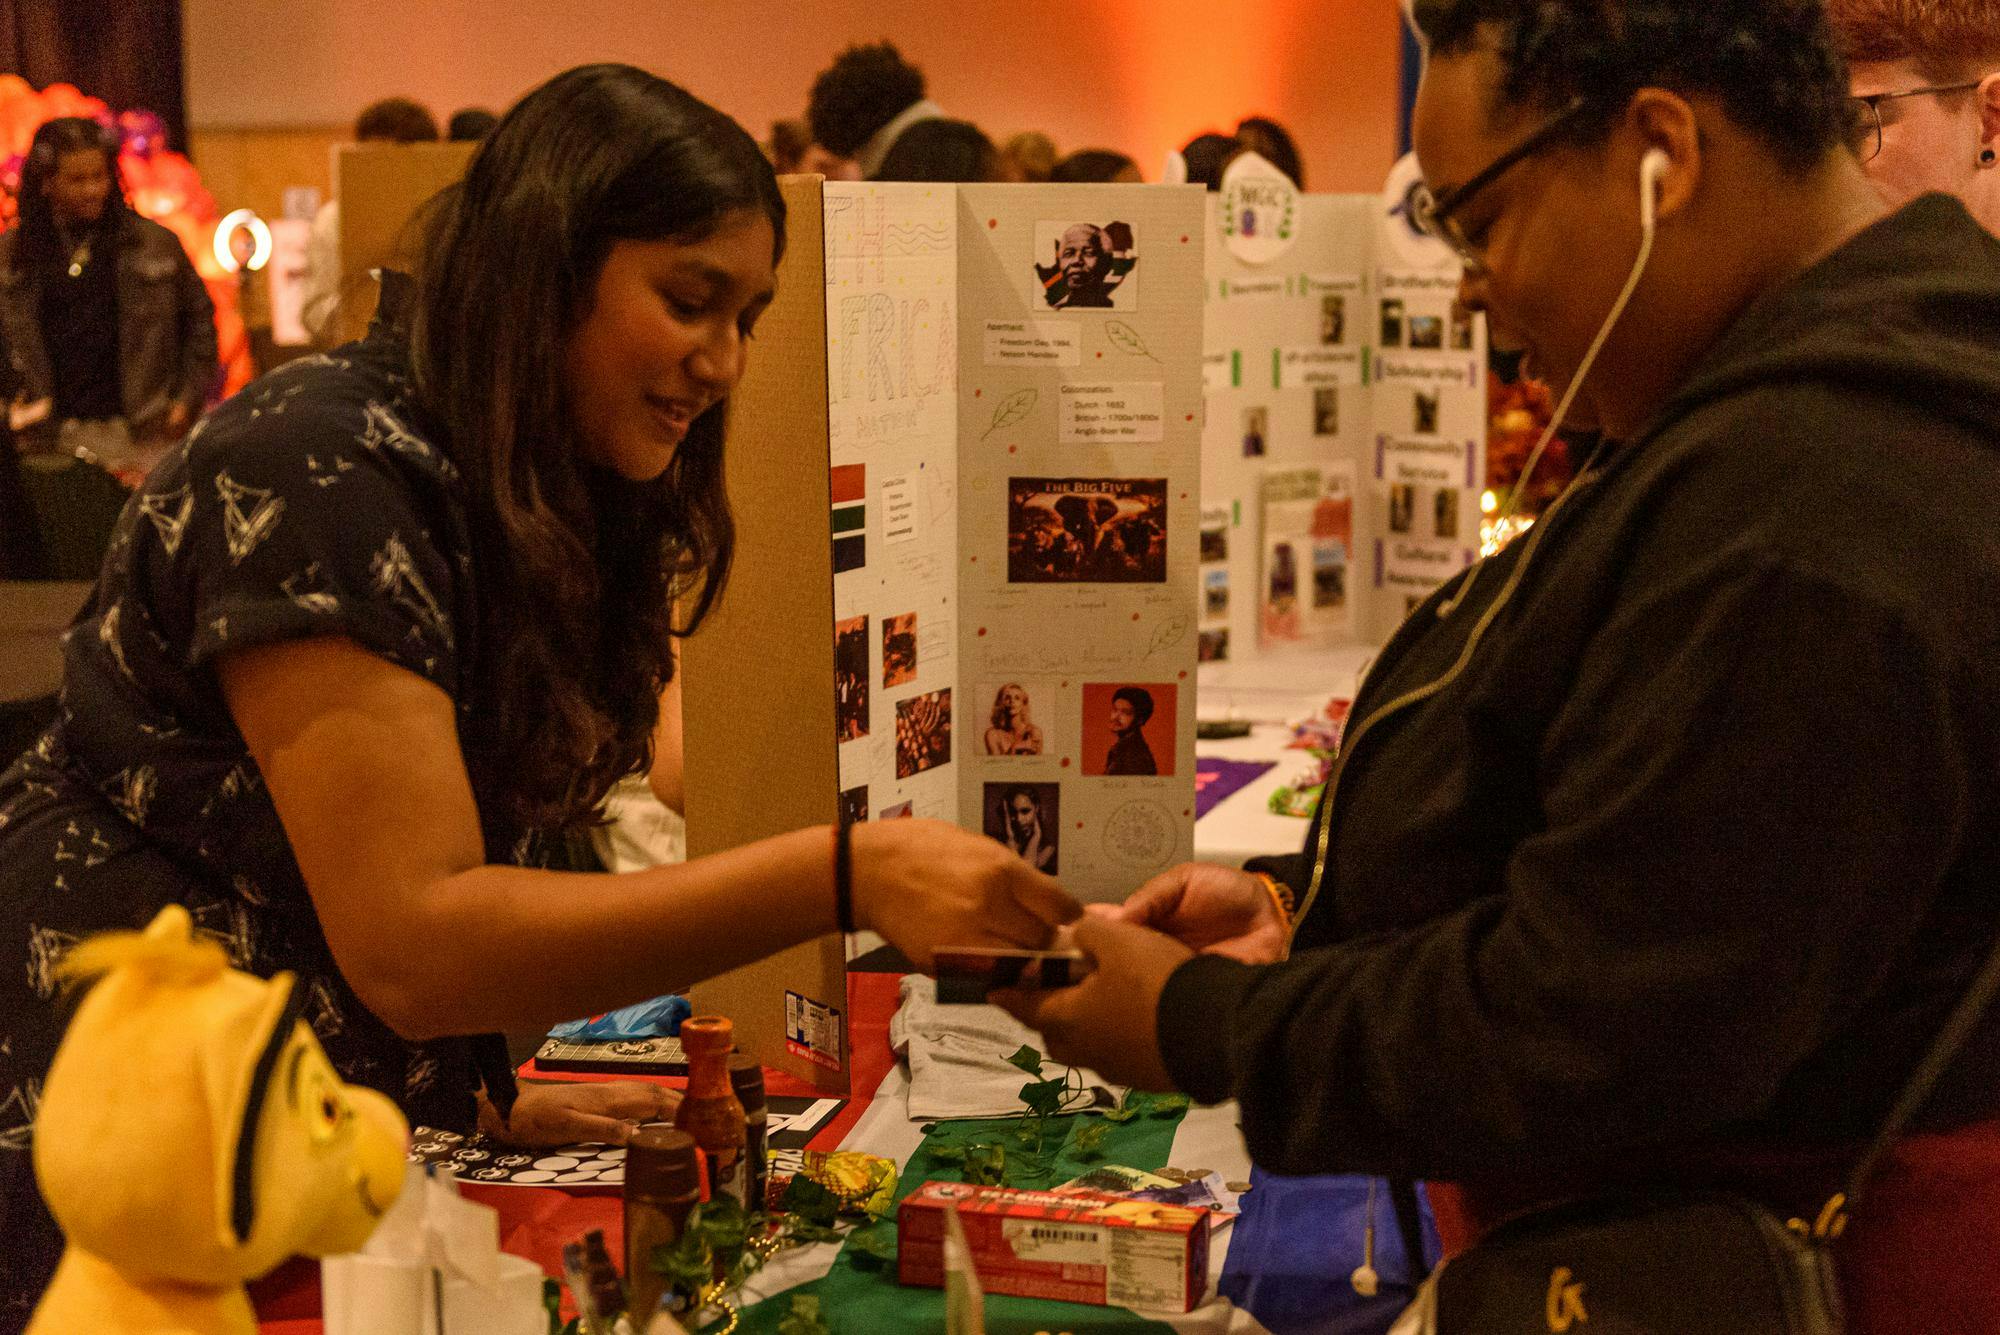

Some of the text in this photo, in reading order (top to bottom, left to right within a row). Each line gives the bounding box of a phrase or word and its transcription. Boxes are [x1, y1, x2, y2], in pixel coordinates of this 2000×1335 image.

[1045, 481, 1132, 493] THE BIG FIVE
